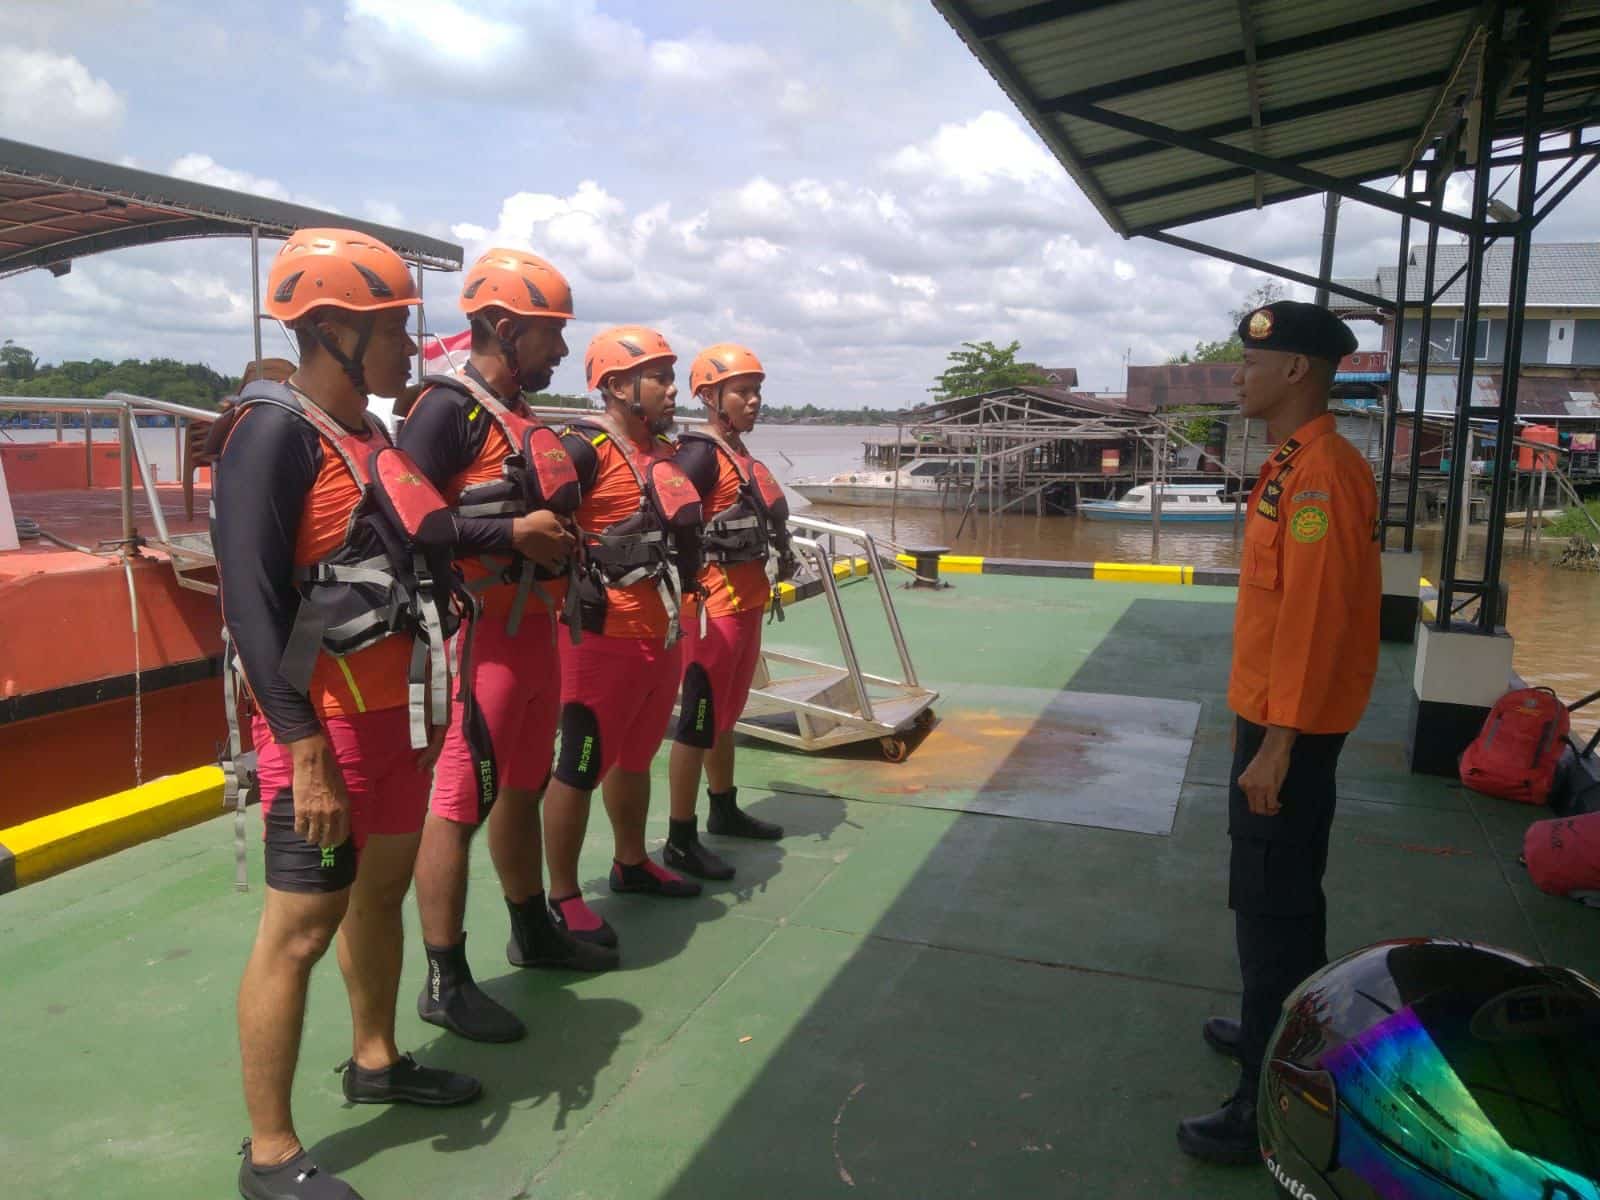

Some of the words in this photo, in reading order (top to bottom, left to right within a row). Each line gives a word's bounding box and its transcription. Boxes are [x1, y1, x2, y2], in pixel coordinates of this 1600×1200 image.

[695, 698, 707, 731] RESCUE
[579, 735, 593, 773] RESCUE
[480, 759, 493, 804] RESCUE
